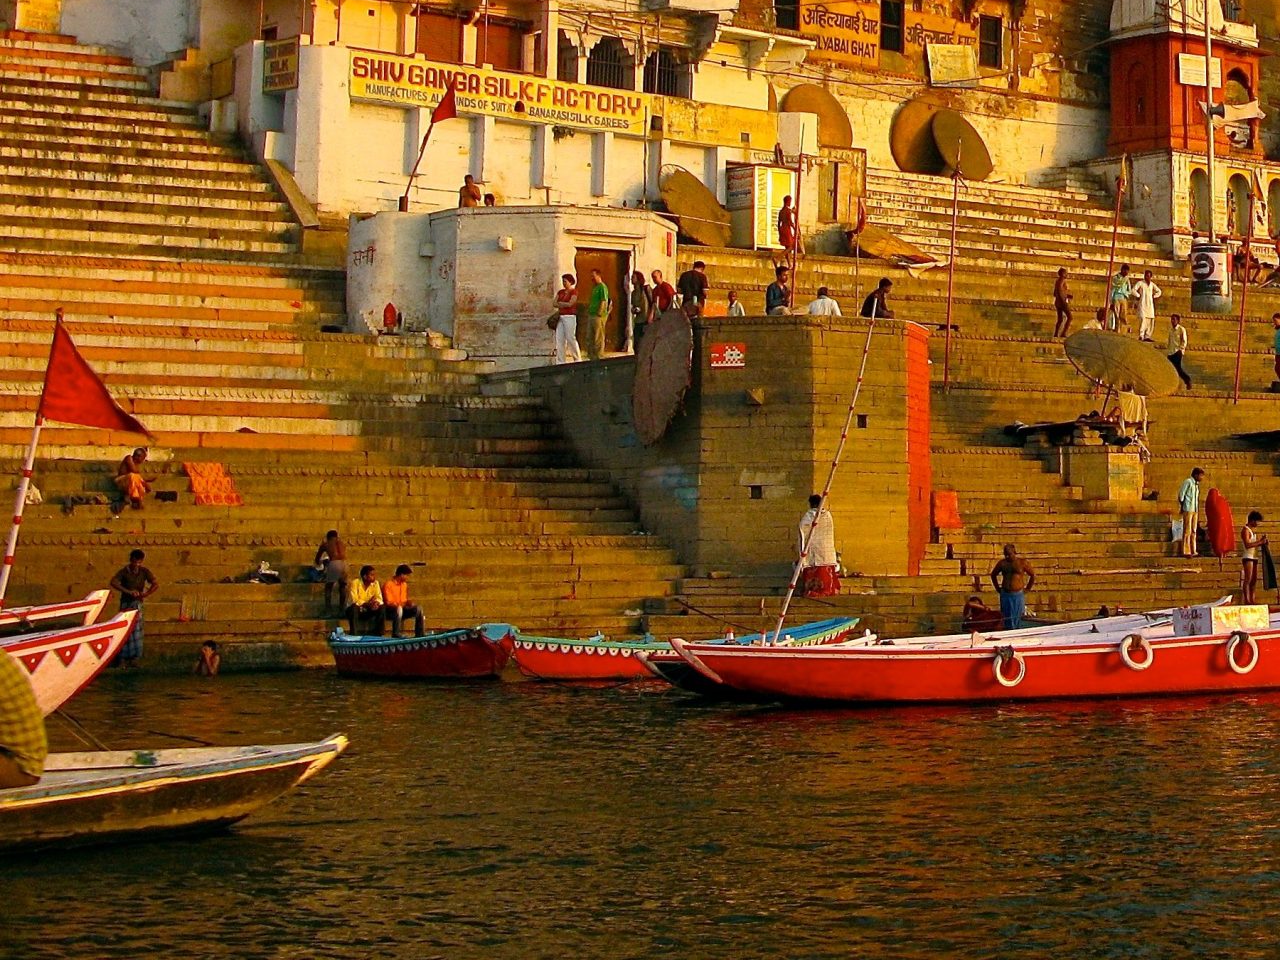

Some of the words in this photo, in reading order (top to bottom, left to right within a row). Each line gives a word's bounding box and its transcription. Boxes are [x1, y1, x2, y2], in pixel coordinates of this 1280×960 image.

[802, 5, 861, 35] अहिल्याबाई
[862, 11, 878, 36] घाट
[851, 39, 876, 58] GHAT
[353, 56, 405, 84] SHIV
[408, 64, 481, 94] GANGA
[484, 75, 534, 102] SILK
[537, 83, 642, 117] FACTORY
[365, 83, 428, 102] MANUFACTURES
[456, 96, 477, 109] INDS
[477, 100, 488, 110] OF
[491, 101, 507, 113] SUIT
[529, 106, 569, 121] BANARASI
[594, 116, 629, 129] SAREES
